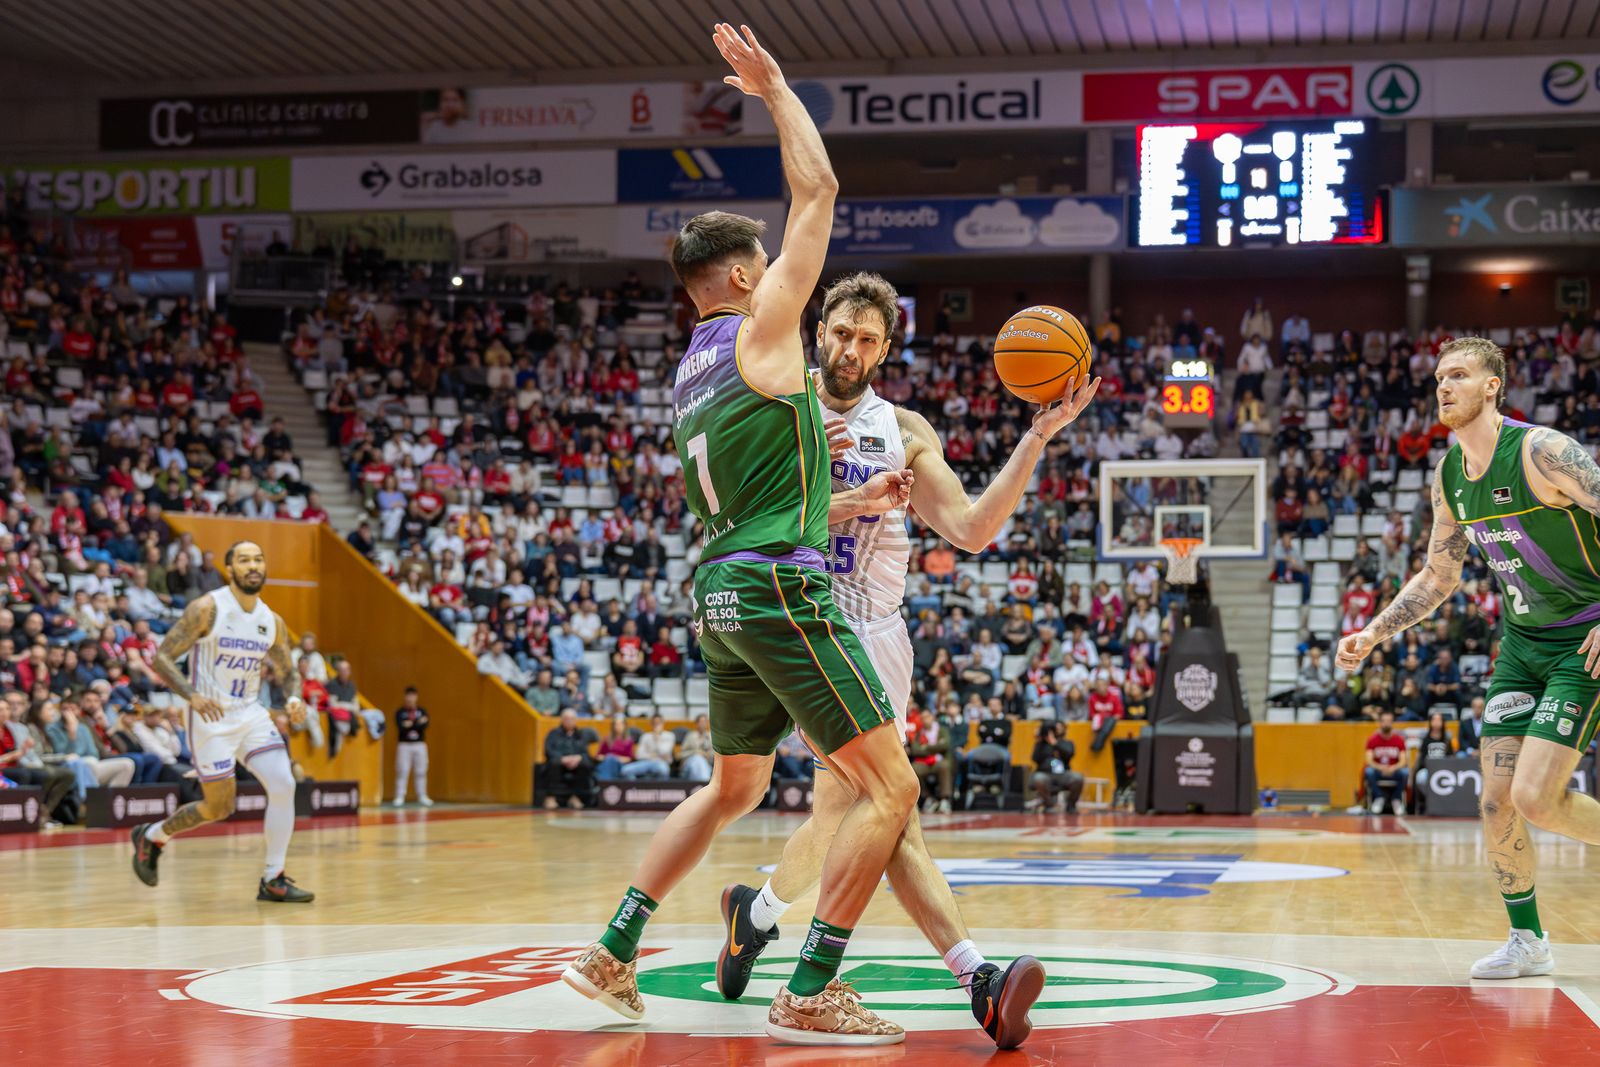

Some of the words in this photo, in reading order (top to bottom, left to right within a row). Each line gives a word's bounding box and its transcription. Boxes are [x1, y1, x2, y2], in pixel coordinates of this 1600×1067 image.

[840, 79, 1041, 125] Tecnical
[1158, 73, 1350, 113] SPAR
[399, 162, 543, 189] Grabalosa
[1162, 383, 1210, 415] 3.8
[686, 431, 720, 516] 7
[1477, 527, 1523, 545] Unicaja
[705, 591, 740, 607] COSTA
[720, 606, 741, 619] SOL
[1506, 584, 1530, 616] 2
[611, 896, 641, 930] UNICAJA
